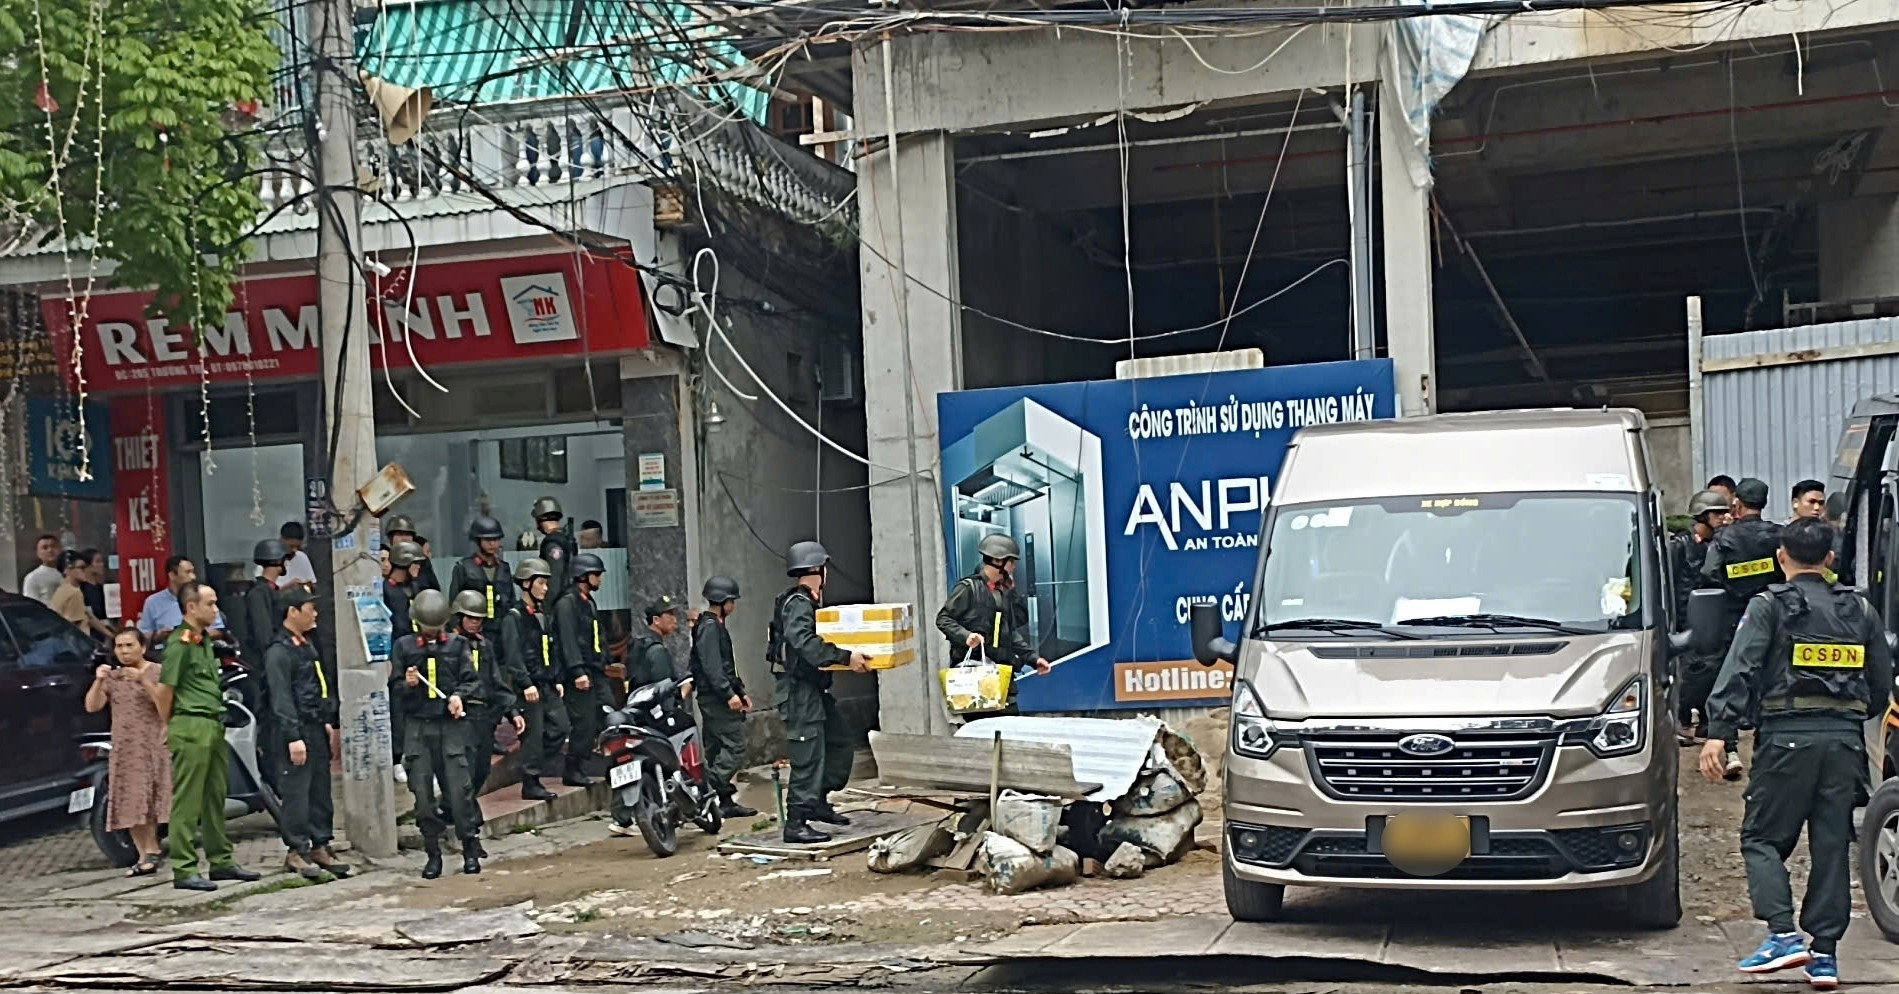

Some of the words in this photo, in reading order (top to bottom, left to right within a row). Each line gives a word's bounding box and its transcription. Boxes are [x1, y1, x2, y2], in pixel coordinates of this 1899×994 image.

[262, 292, 492, 351] MNH
[1128, 403, 1173, 440] CÔNG
[1176, 399, 1218, 436] TRÌNH
[1220, 394, 1239, 433] SỬ
[1241, 400, 1284, 438] DỤNG
[1286, 396, 1339, 428] THANG
[1341, 386, 1375, 421] MÁY
[115, 427, 159, 471] THIẾT
[128, 486, 151, 531] KẾ
[1184, 537, 1207, 551] AN
[1212, 532, 1258, 549] TOÀN
[128, 558, 156, 592] THI
[1802, 647, 1857, 662] CSĐN
[1124, 667, 1234, 693] Hotline:
